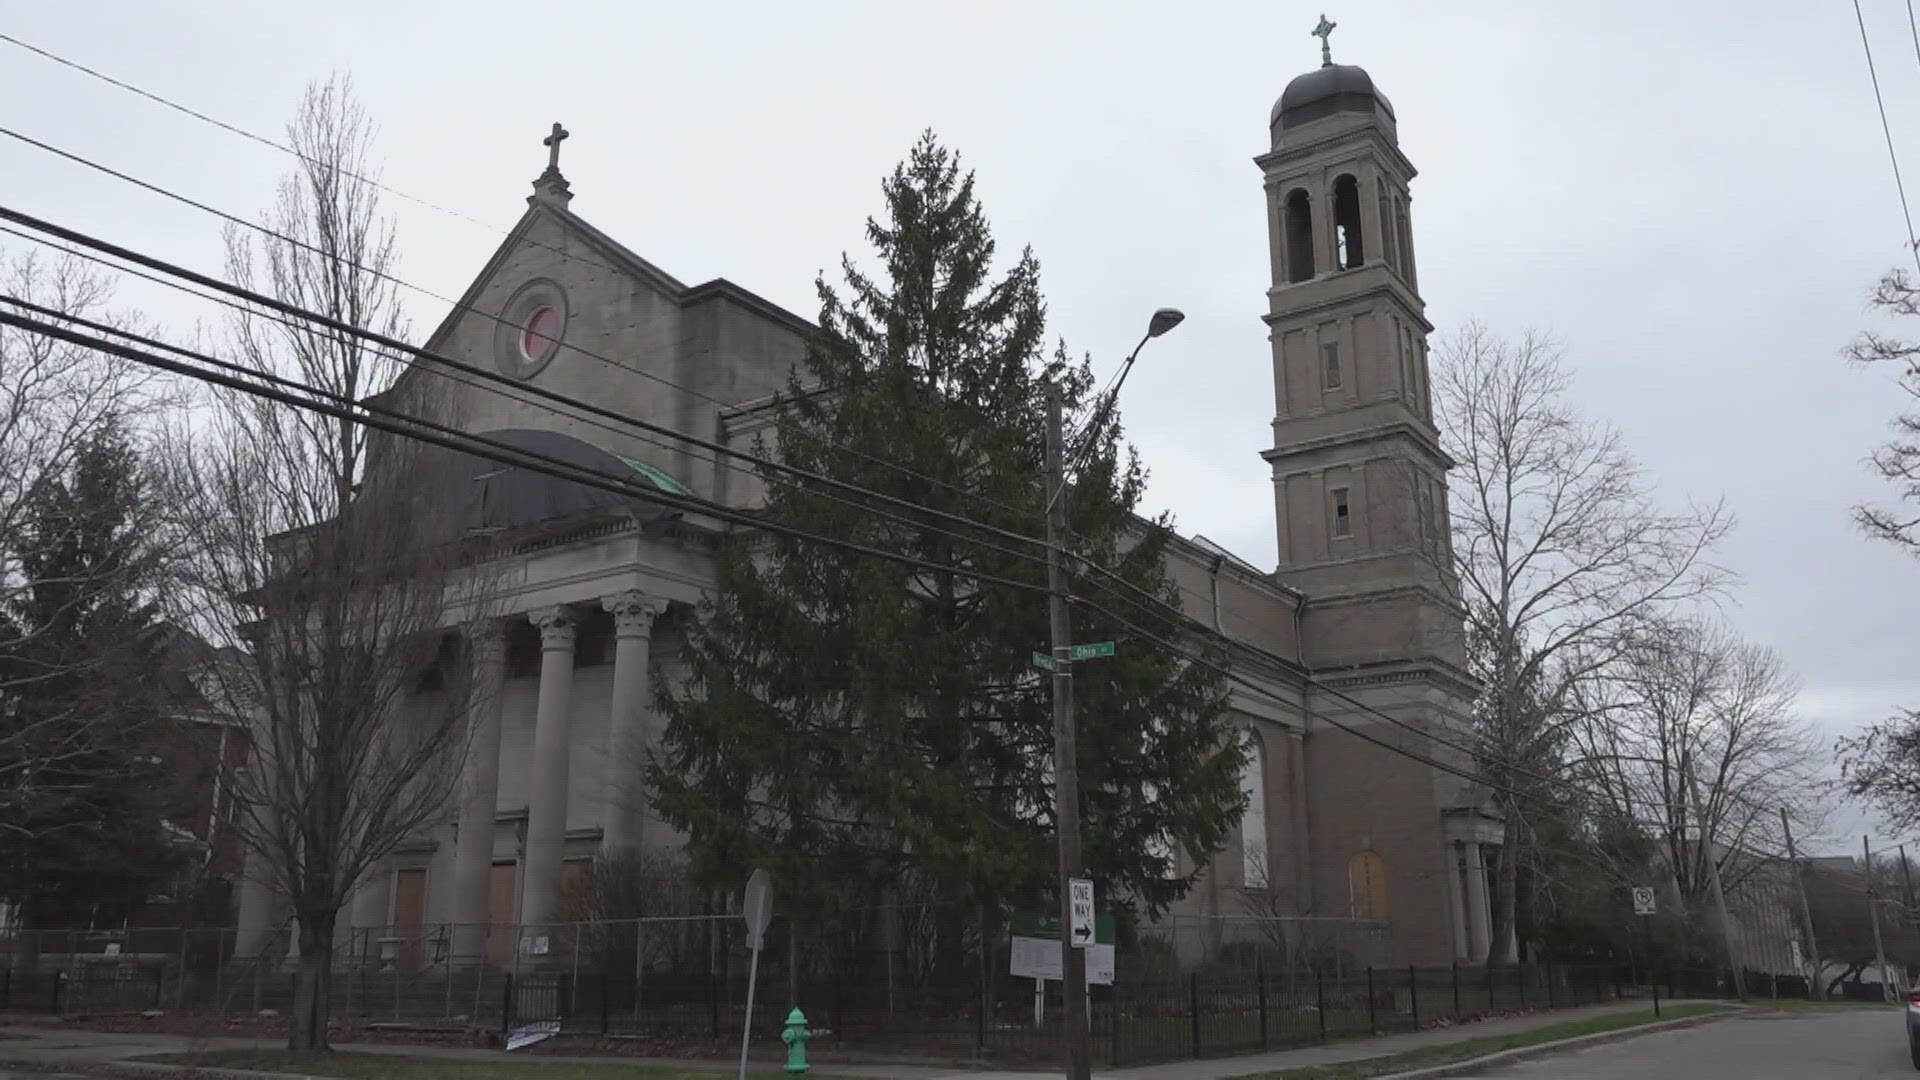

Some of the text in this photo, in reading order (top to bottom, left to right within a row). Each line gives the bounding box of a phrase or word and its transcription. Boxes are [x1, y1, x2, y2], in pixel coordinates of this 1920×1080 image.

[1076, 647, 1096, 658] Ohio
[1073, 885, 1090, 900] ONE
[1074, 903, 1091, 920] WAY
